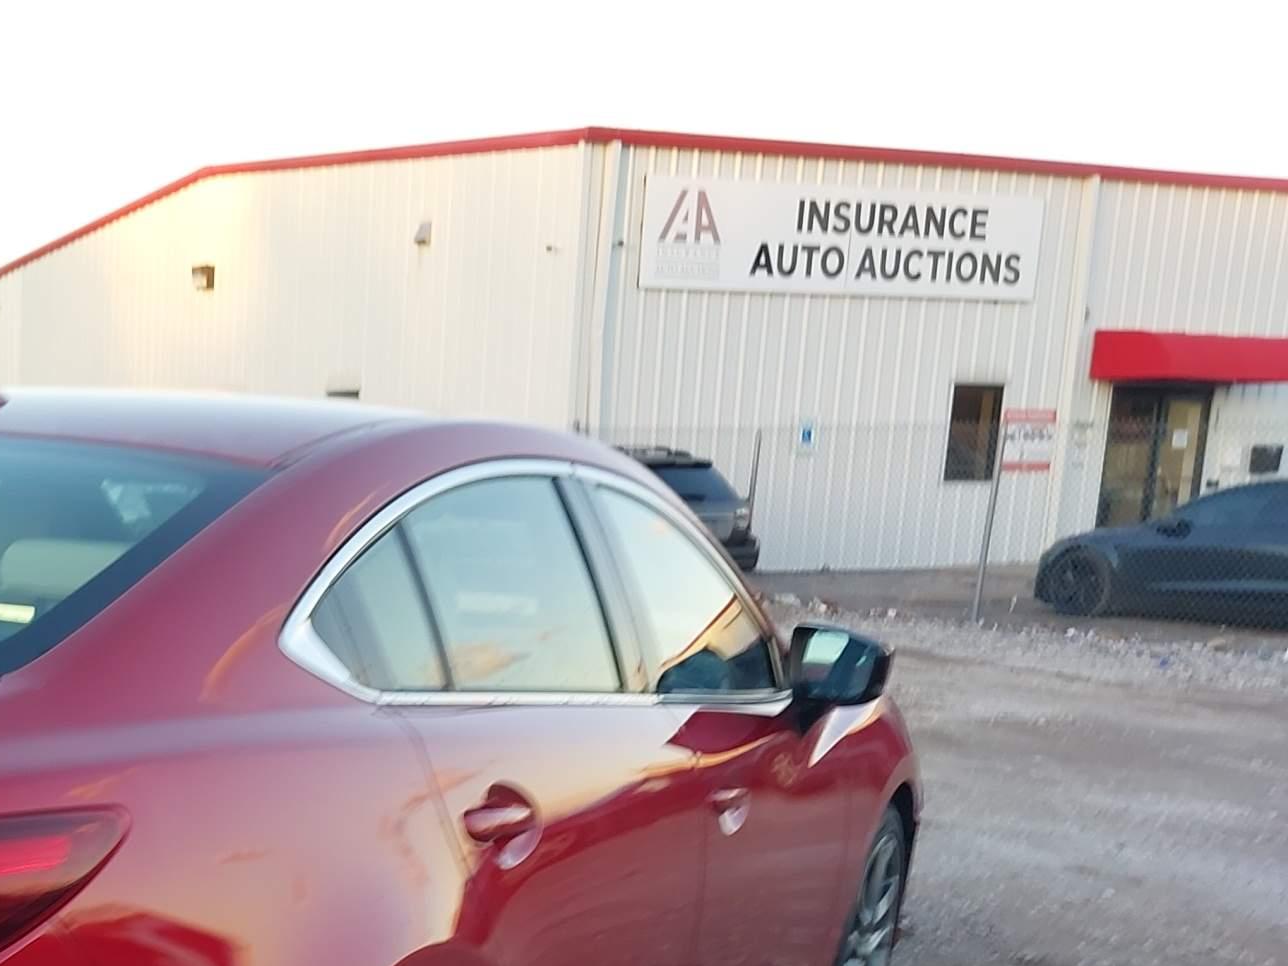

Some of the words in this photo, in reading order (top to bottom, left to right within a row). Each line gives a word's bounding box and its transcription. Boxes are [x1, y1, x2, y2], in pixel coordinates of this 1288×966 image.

[796, 199, 989, 240] INSURANCE
[749, 242, 845, 279] AUTO
[854, 247, 1021, 285] AUCTIONS
